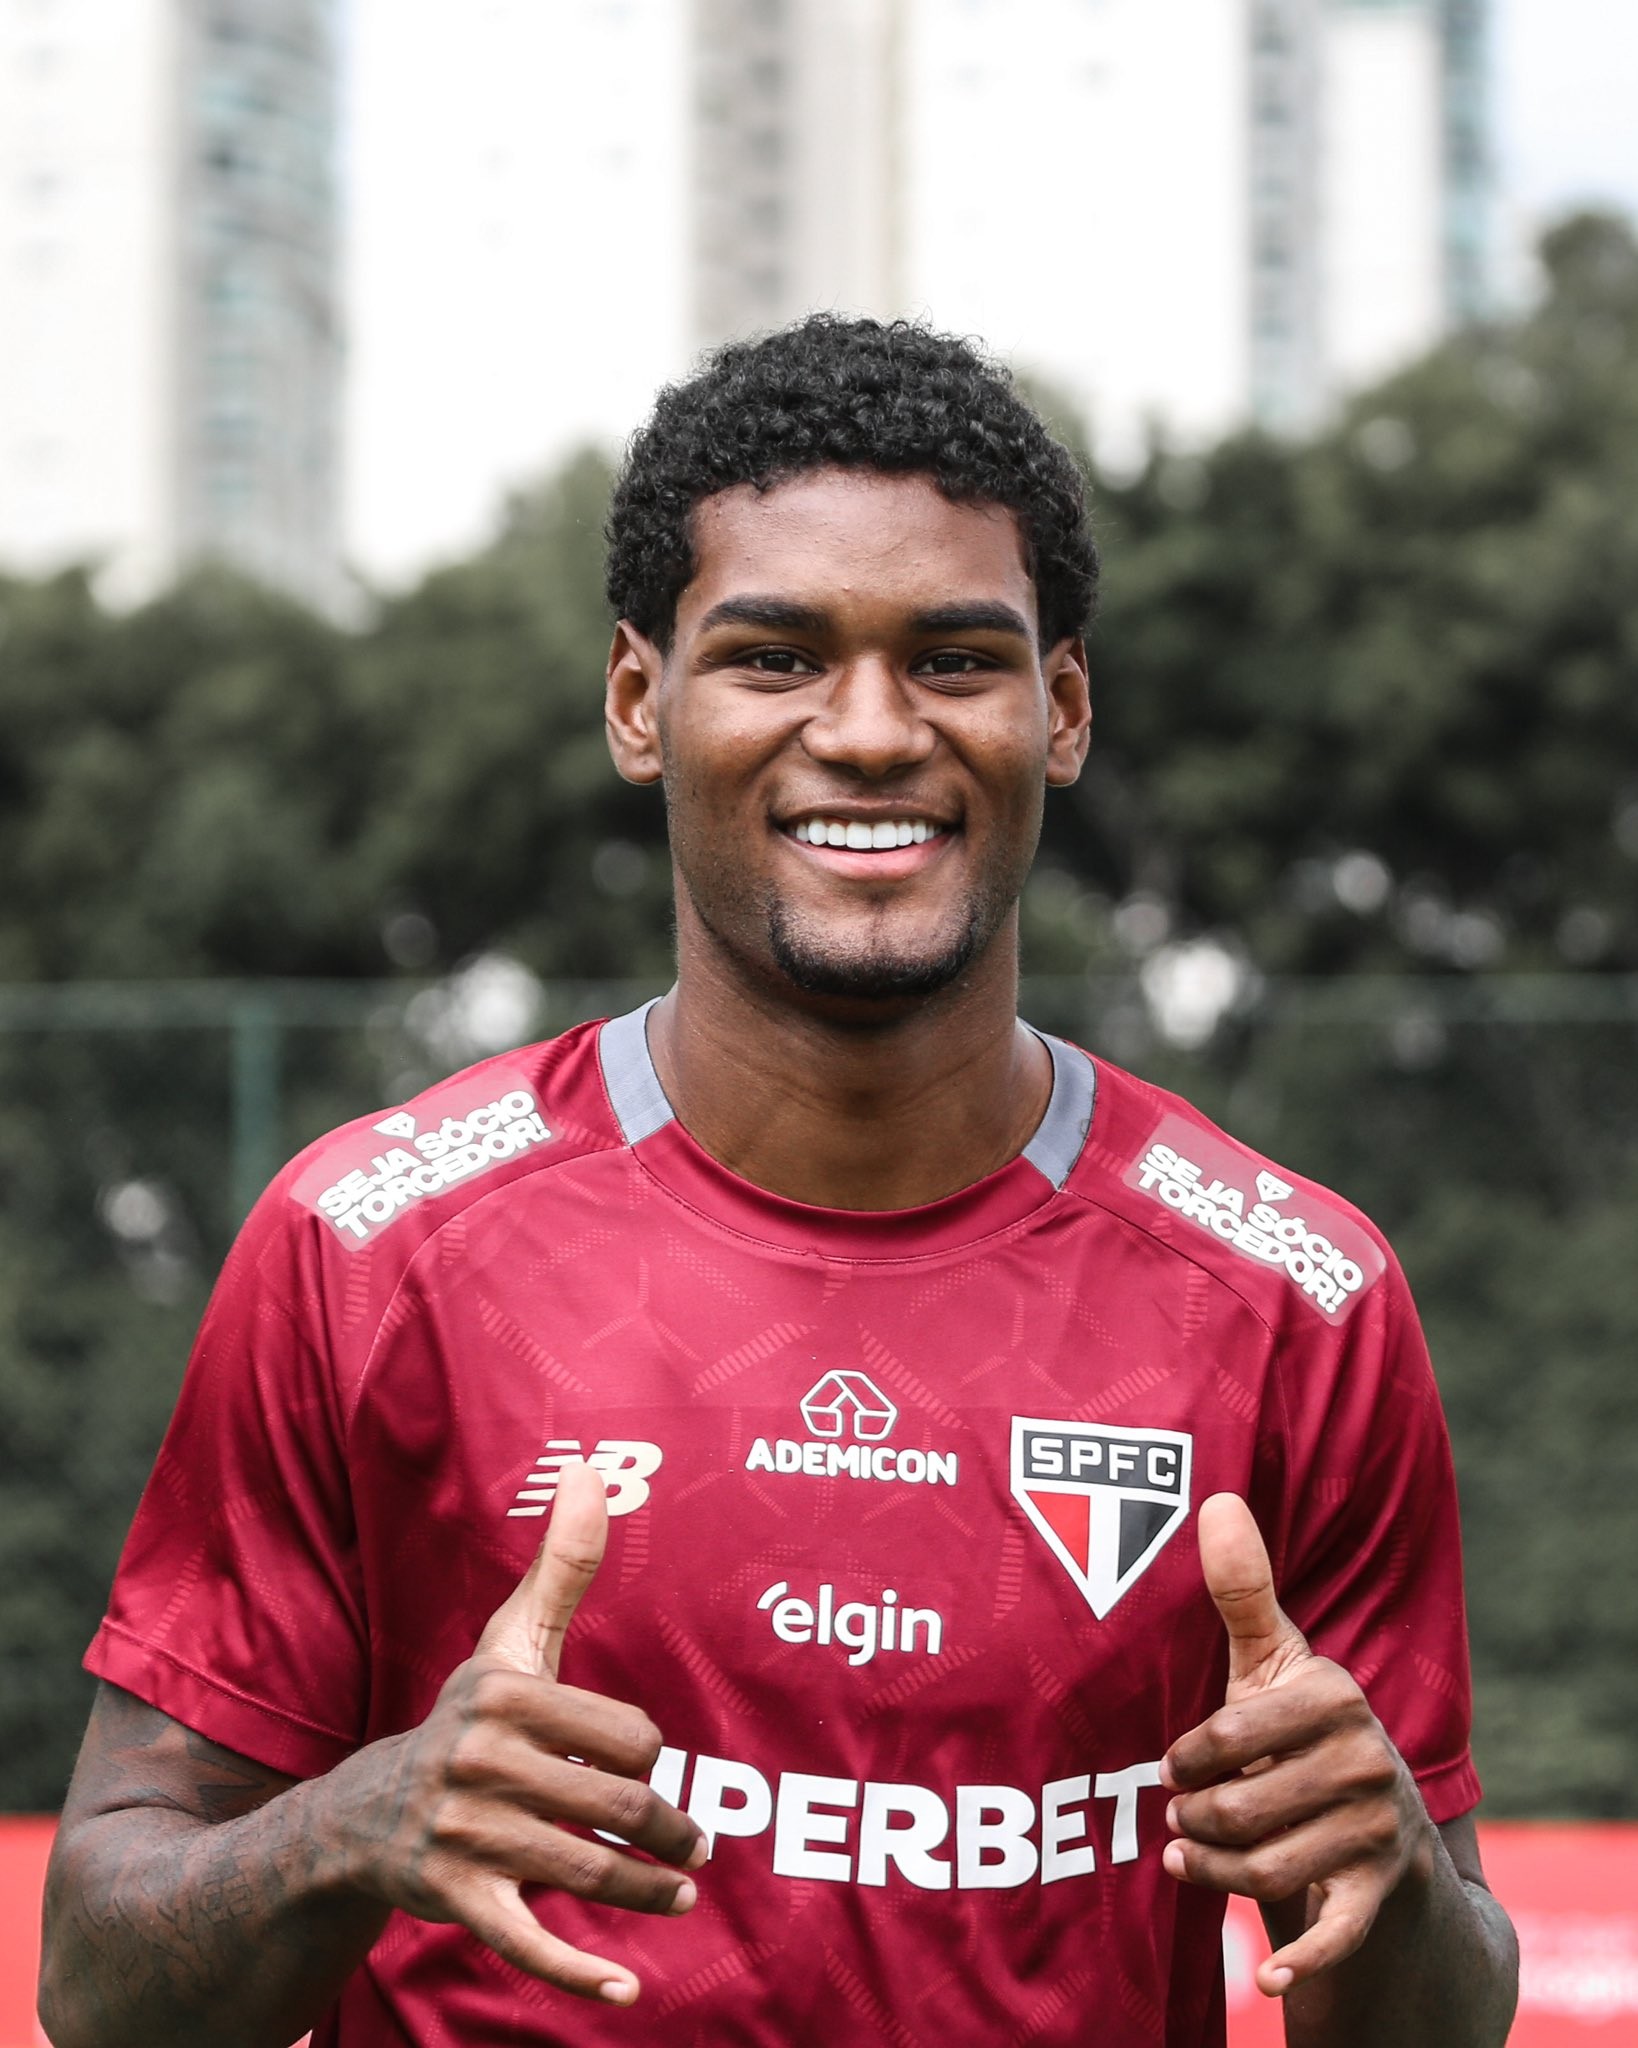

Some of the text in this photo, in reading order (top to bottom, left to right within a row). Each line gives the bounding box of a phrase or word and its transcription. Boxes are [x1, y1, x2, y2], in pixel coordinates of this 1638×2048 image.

[317, 1090, 536, 1217] SEJA SÓCIO
[335, 1112, 552, 1238] TORCEDOR!
[1138, 1161, 1348, 1315] TORCEDOR!
[1145, 1143, 1364, 1292] SEJA SÓCIO
[745, 1437, 959, 1486] ADEMICON
[1030, 1437, 1177, 1487] SPFC
[757, 1581, 943, 1666] elgin
[567, 1745, 1163, 1891] PERBET
